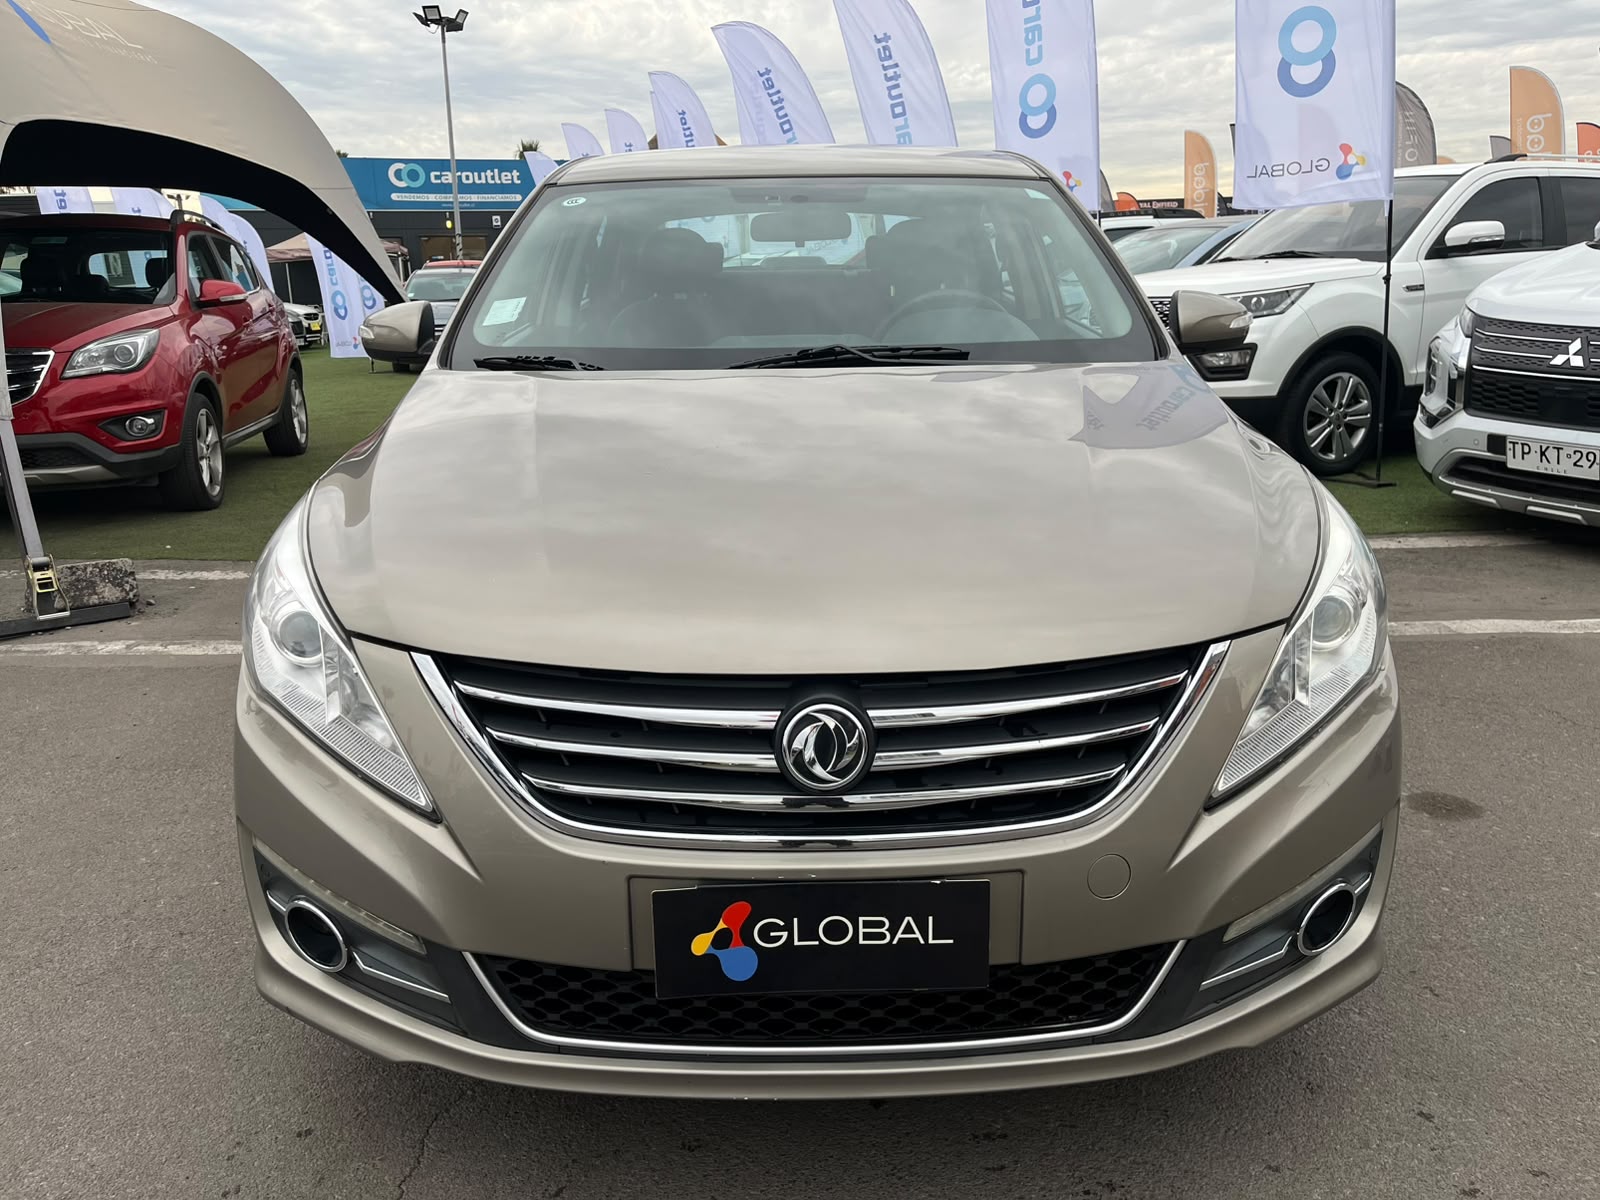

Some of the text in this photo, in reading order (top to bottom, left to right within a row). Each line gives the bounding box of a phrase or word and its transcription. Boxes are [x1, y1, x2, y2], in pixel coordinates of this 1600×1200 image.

[430, 168, 522, 185] caroutlet
[1536, 465, 1568, 475] CHILE
[752, 915, 955, 948] GLOBAL
